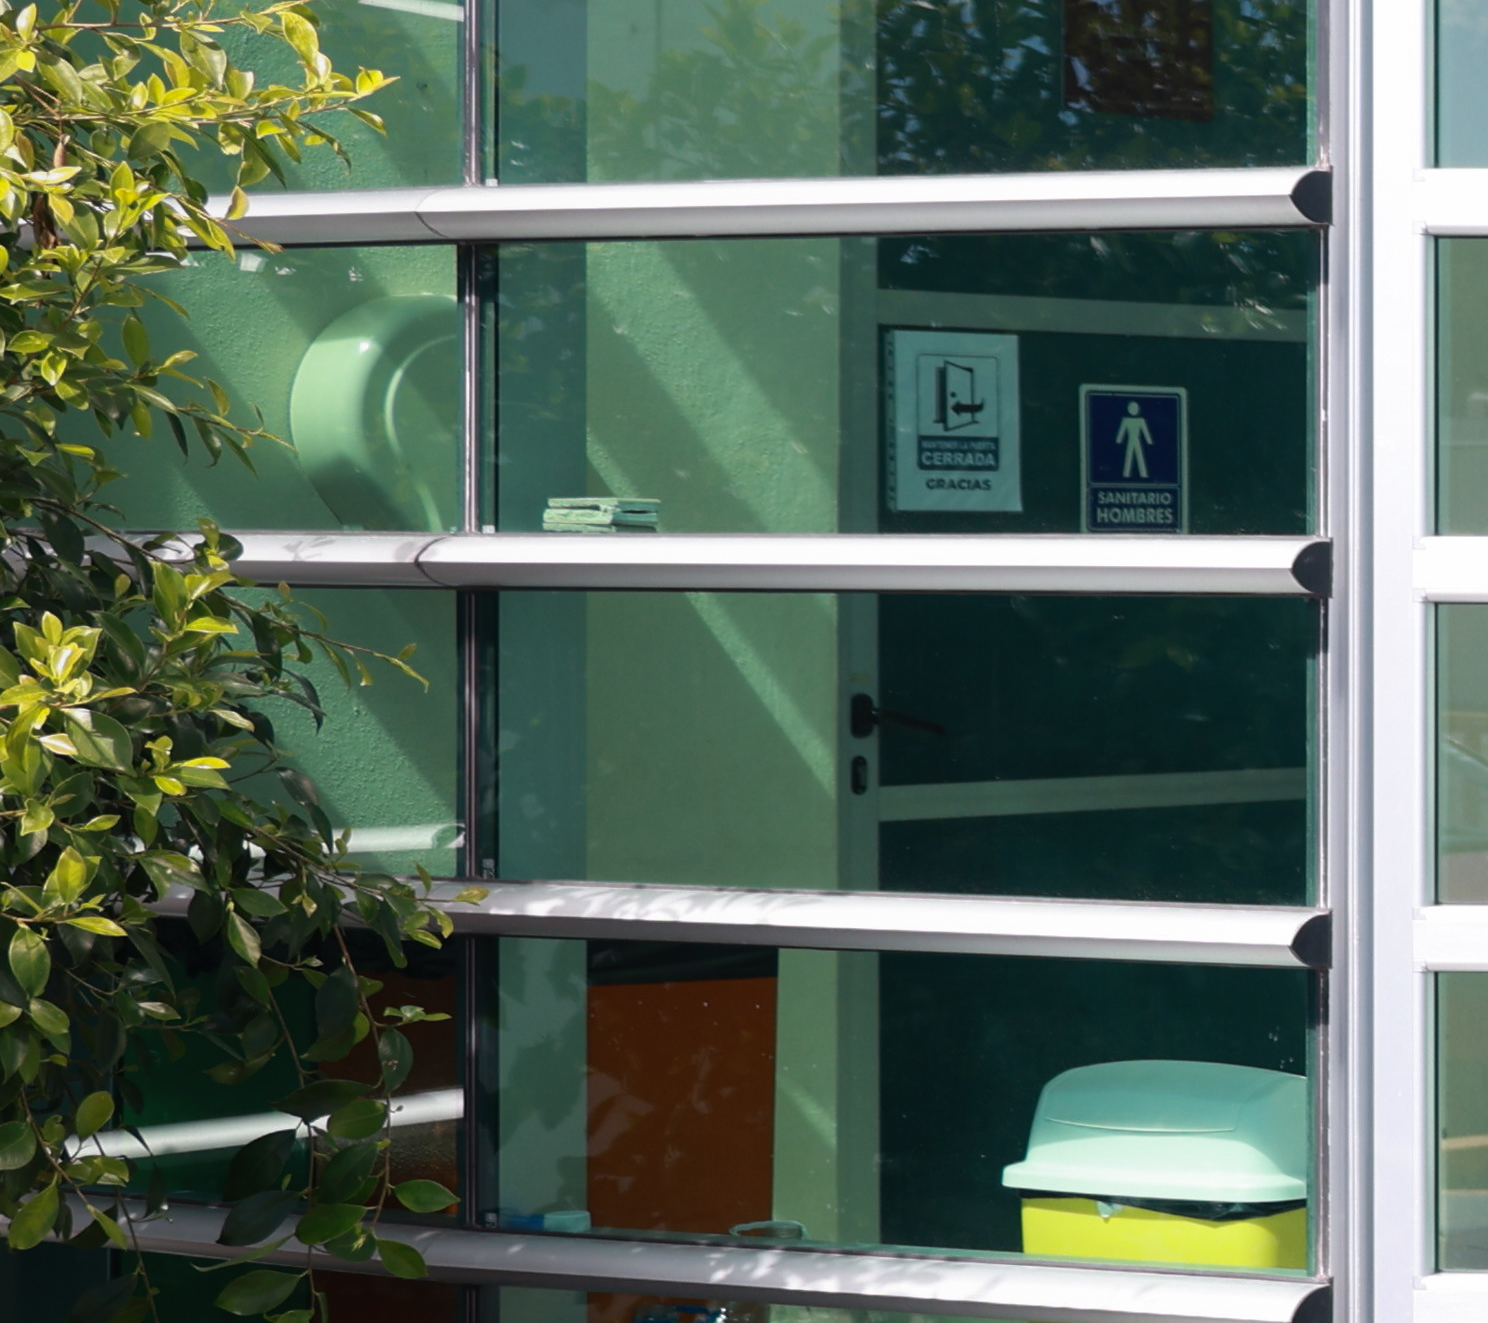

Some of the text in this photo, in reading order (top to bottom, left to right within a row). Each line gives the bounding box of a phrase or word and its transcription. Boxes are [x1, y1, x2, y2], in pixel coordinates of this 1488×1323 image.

[921, 450, 996, 466] CERRADA
[925, 478, 992, 491] GRACIAS
[1098, 490, 1172, 505] SANITARIO
[1097, 507, 1173, 524] HOMBRES
